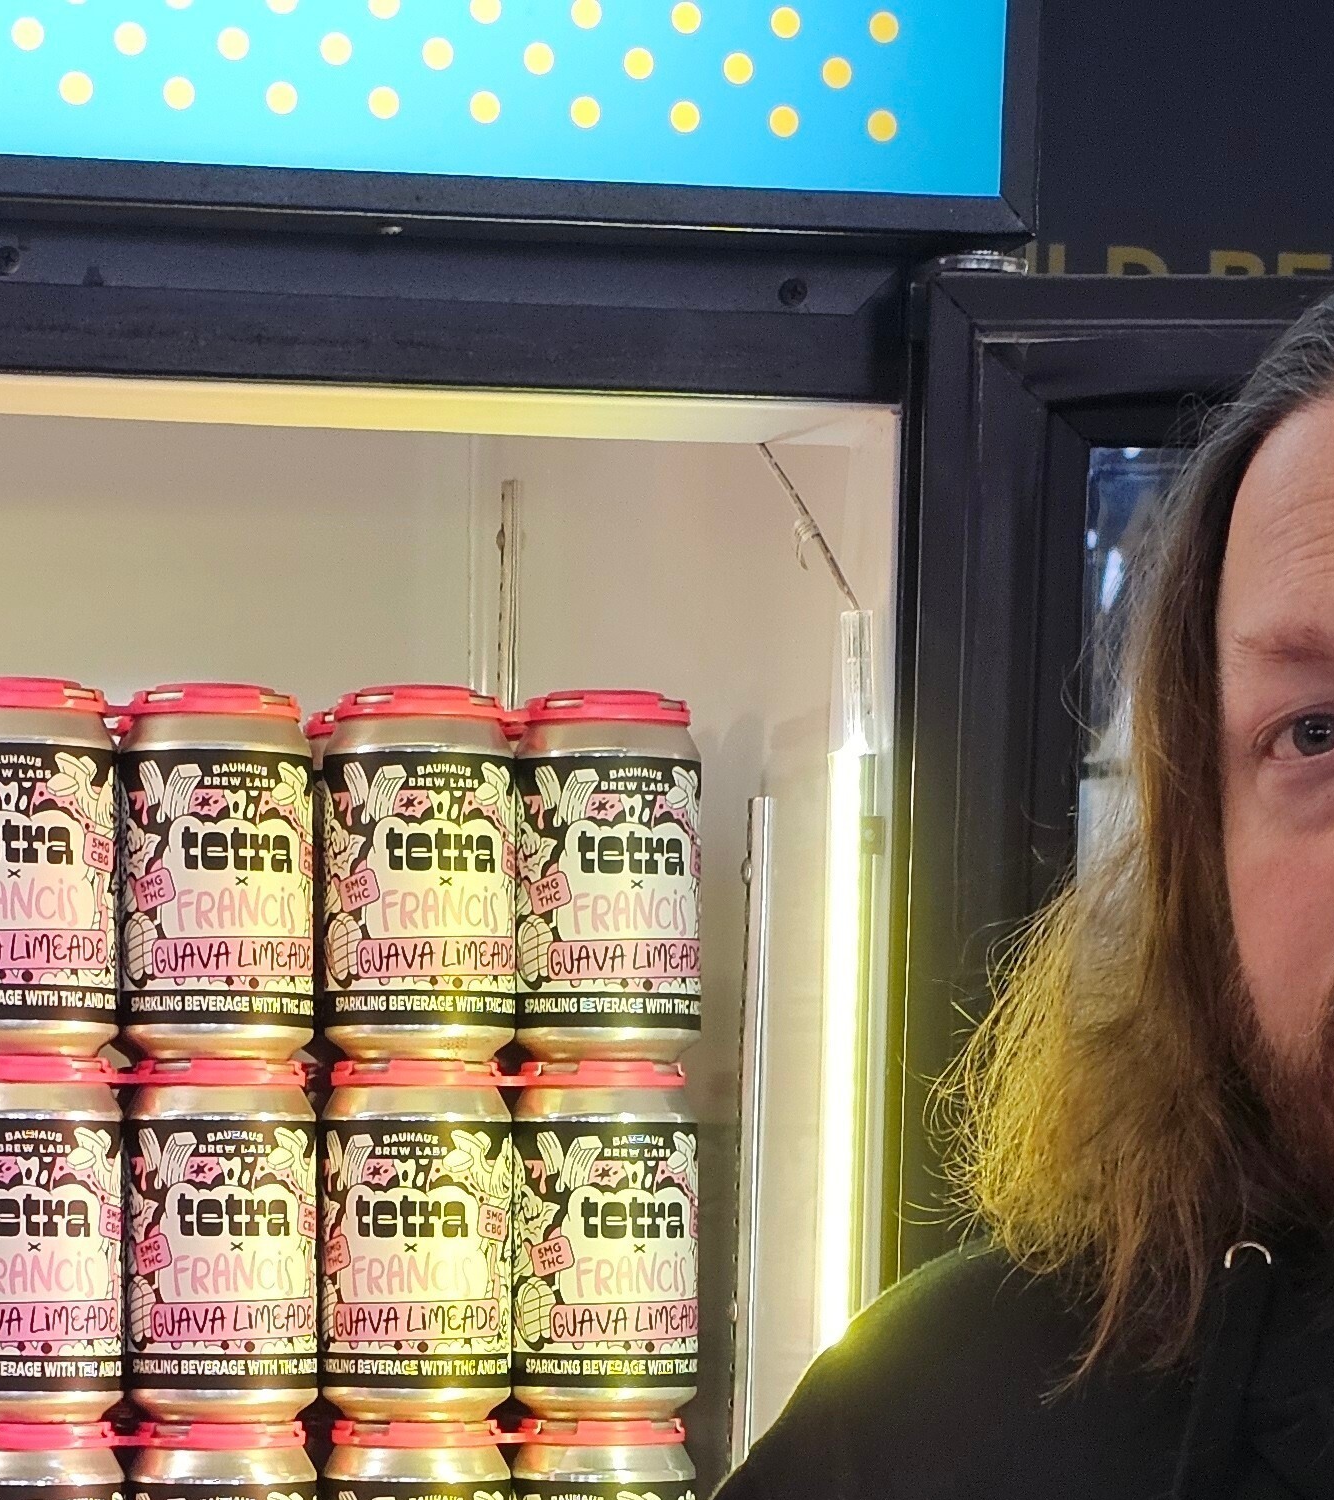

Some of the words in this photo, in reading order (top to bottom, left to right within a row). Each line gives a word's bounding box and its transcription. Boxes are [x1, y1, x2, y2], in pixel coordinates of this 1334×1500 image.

[18, 768, 52, 779] LABS
[204, 777, 238, 788] BREW
[245, 777, 276, 788] LABS
[212, 763, 268, 776] BAUHAUS
[609, 768, 663, 780] BAUHAUS
[600, 780, 638, 791] BREW
[641, 781, 669, 792] LABS
[181, 826, 292, 873] tetra
[386, 826, 495, 873] tetra
[578, 829, 684, 877] tetra
[140, 878, 163, 892] 5MG
[142, 888, 166, 904] THC
[535, 879, 560, 894] 5MG
[538, 891, 562, 906] THC
[154, 940, 232, 973] GUAVA
[360, 941, 435, 975] GUAVA
[550, 943, 627, 976] GUAVA
[26, 991, 57, 1006] WITH
[60, 992, 83, 1007] THC
[525, 998, 577, 1014] SPARKLING
[177, 1192, 290, 1238] tetra
[355, 1194, 469, 1239] tetra
[581, 1194, 685, 1239] tetra
[153, 1306, 227, 1338] GUAVA
[334, 1305, 399, 1337] GUAVA
[553, 1306, 627, 1338] GUAVA
